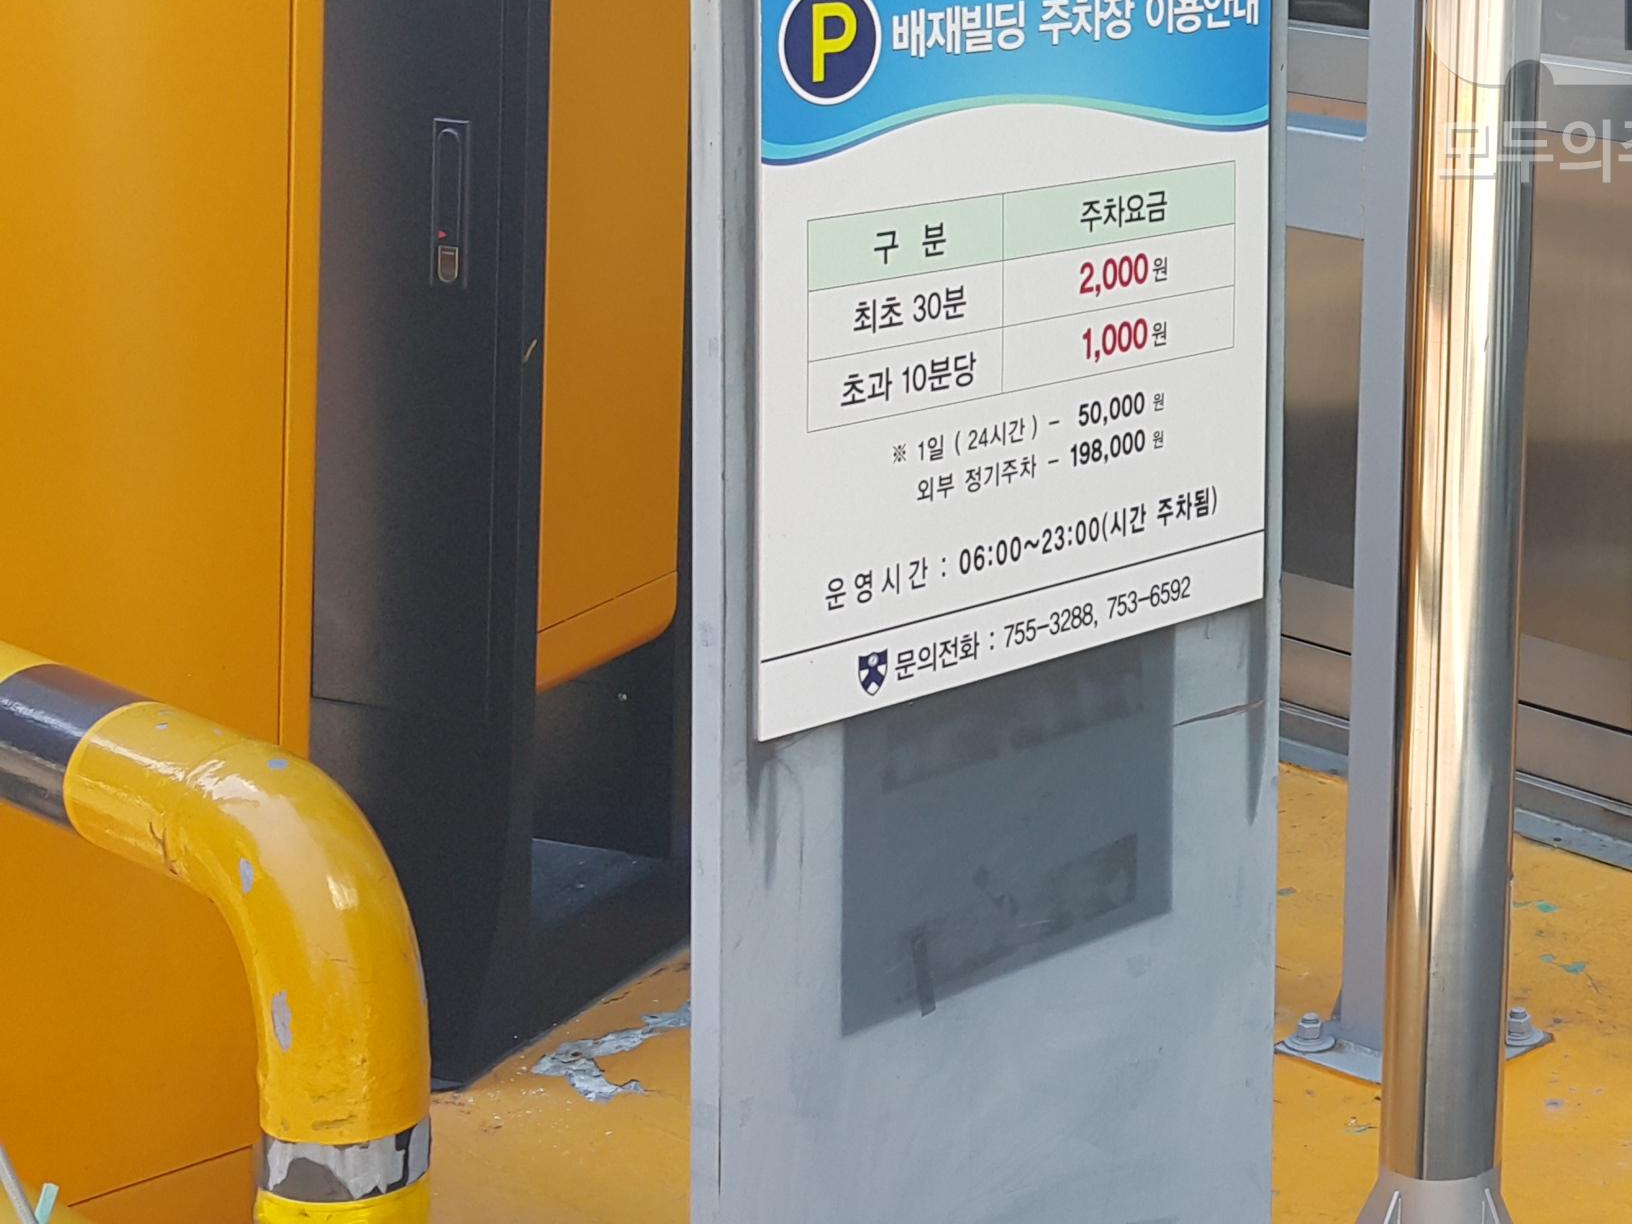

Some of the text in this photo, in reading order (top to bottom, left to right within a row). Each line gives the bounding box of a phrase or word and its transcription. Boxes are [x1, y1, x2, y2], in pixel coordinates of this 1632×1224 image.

[812, 2, 857, 83] P
[892, 0, 1026, 58] 배재빌딩
[1080, 190, 1167, 232] 주차요금
[853, 296, 903, 334] 최초
[913, 284, 967, 322] 30분
[840, 367, 892, 407] 초과
[902, 351, 976, 394] 10분당
[918, 435, 944, 461] 1일
[916, 473, 955, 503] 외부
[964, 454, 1037, 494] 정기주차
[1156, 484, 1218, 528] 주차됨)
[894, 629, 980, 681] 문의전화
[1106, 575, 1192, 620] 753-6592
